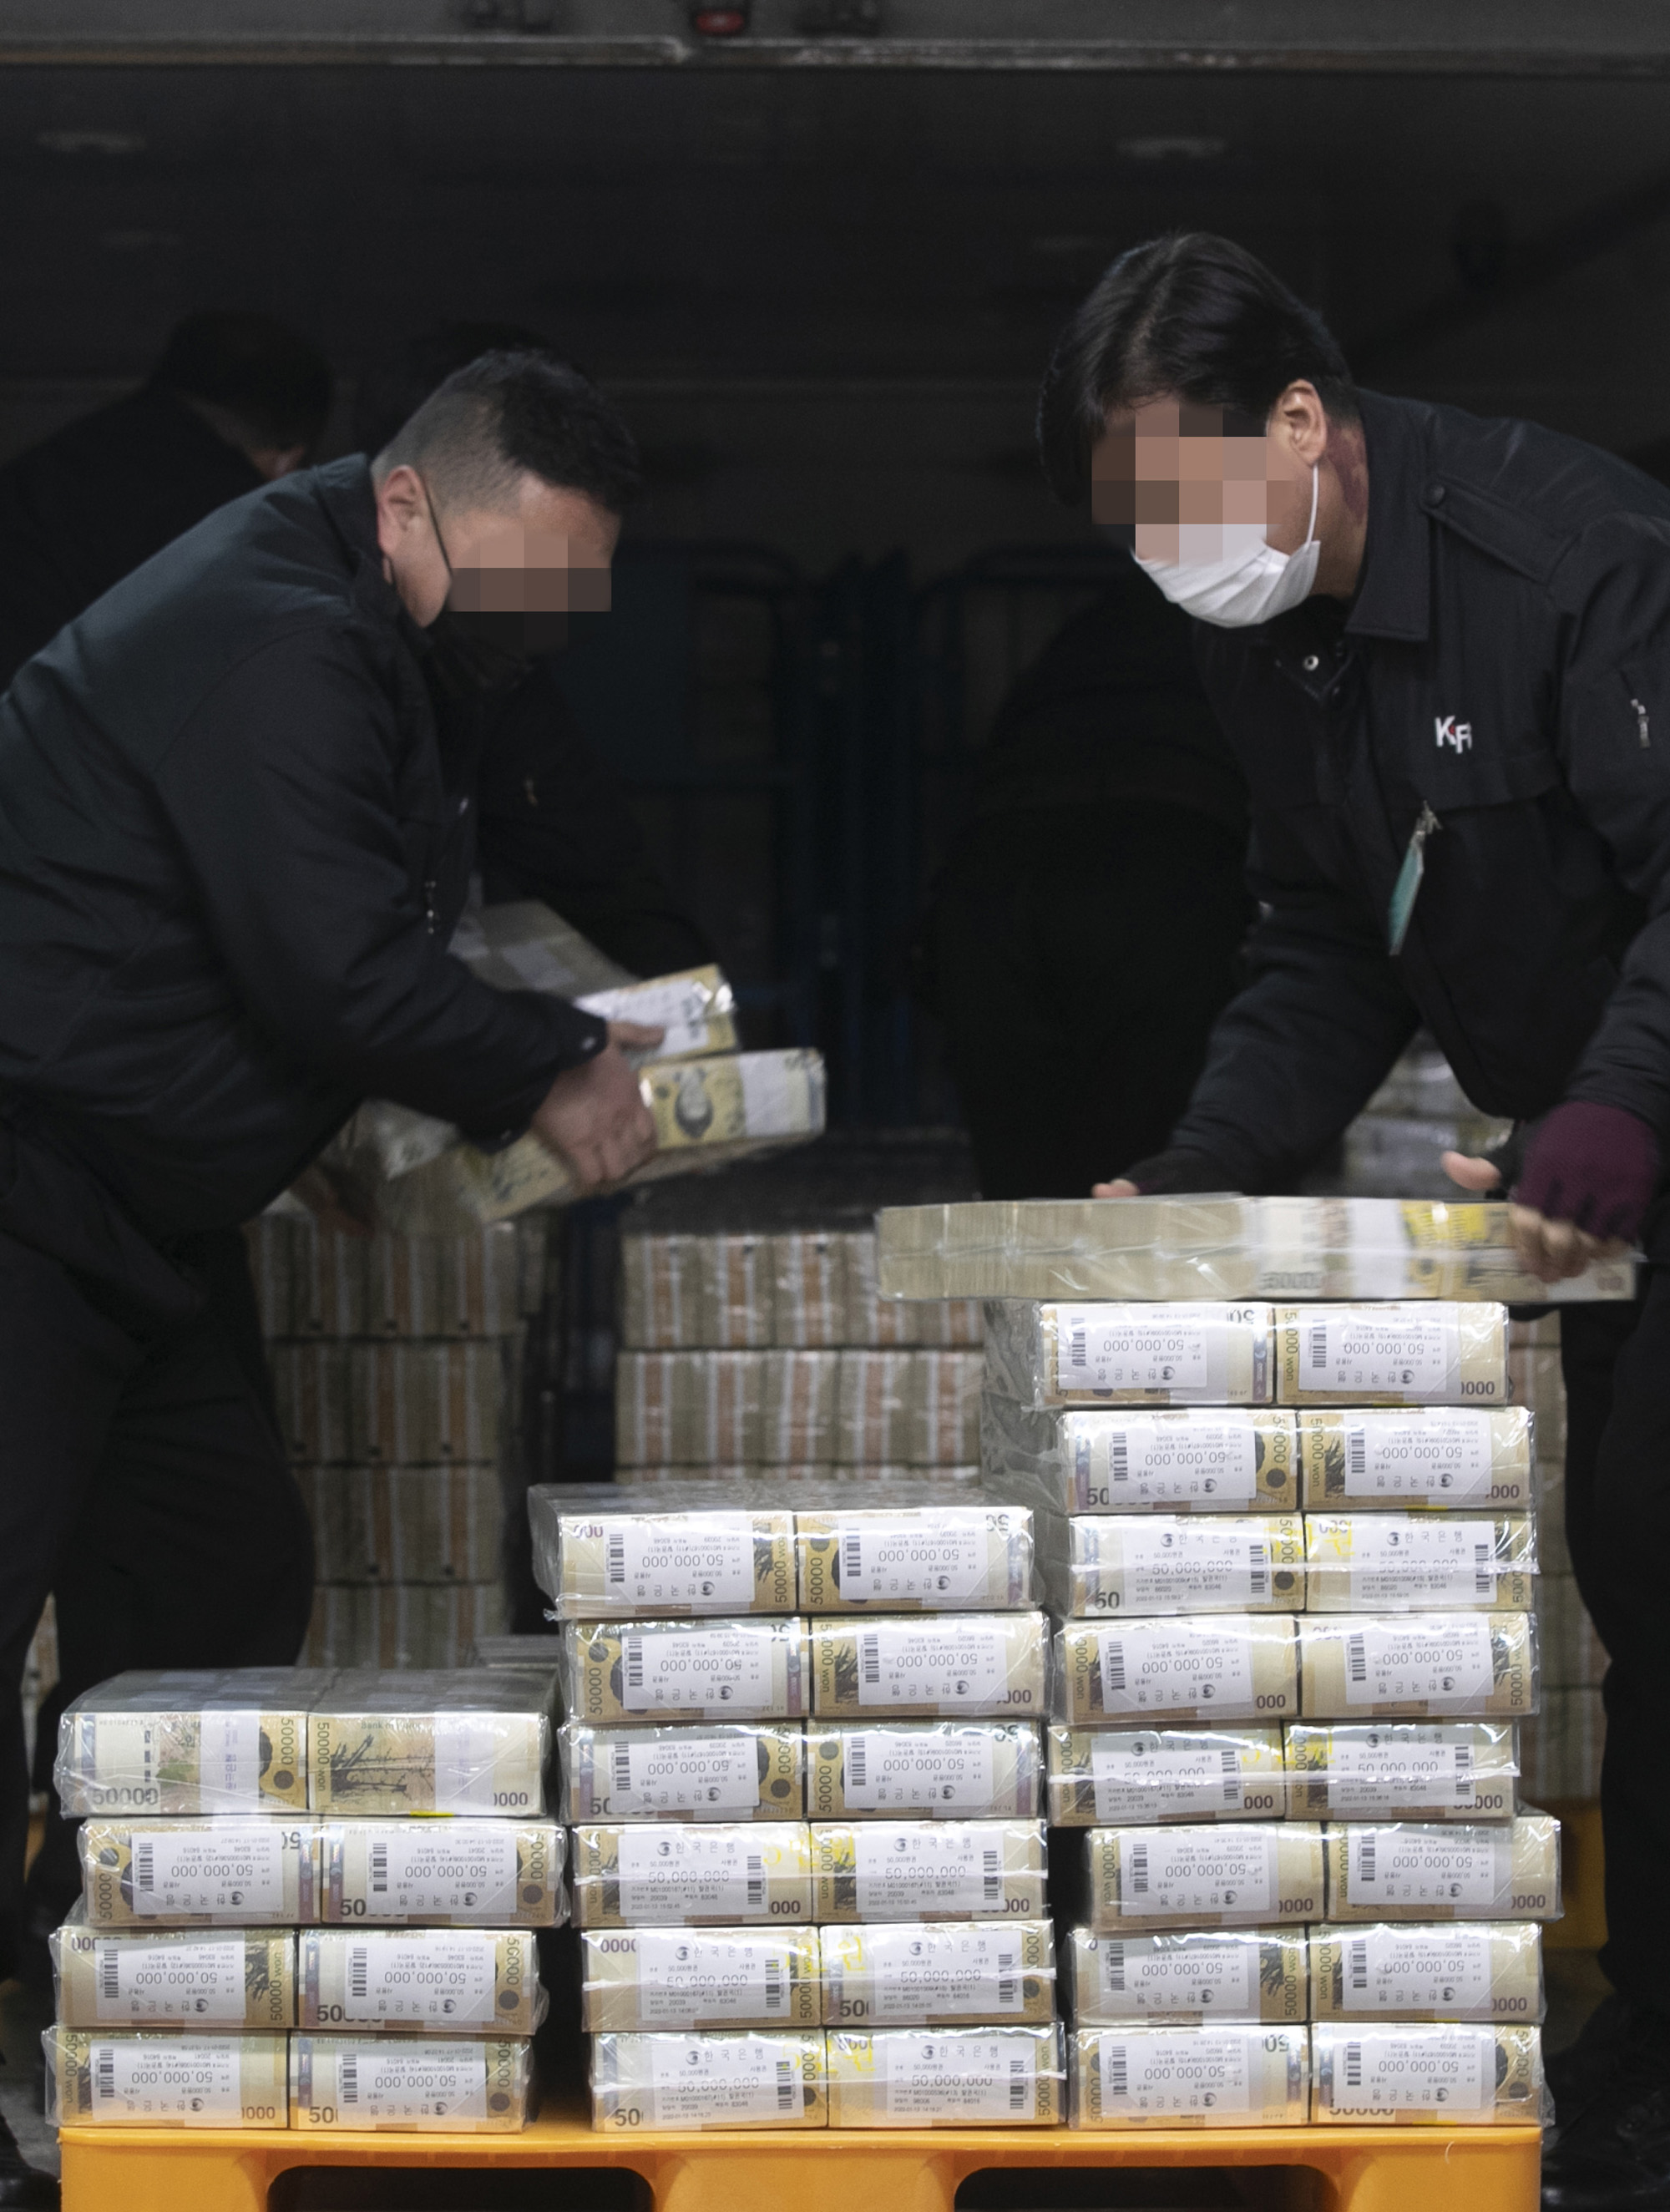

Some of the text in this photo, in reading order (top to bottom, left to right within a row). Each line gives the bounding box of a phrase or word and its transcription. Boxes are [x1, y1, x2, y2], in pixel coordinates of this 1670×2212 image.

[1104, 1339, 1184, 1352] 50,000,000
[1344, 1341, 1424, 1354] 50,000,000
[1145, 1450, 1226, 1465] 50,000,000
[1383, 1445, 1461, 1458] 50,000,000
[642, 1553, 723, 1567] 50,000,000
[878, 1547, 959, 1562] 50,000,000
[774, 1561, 787, 1602] 50000
[811, 1557, 823, 1605] 50000
[897, 1652, 978, 1667] 50,000,000
[1142, 1655, 1222, 1673] 50,000,000
[1383, 1648, 1463, 1665] 50,000,000
[660, 1658, 741, 1671] 50,000,000
[589, 1668, 602, 1715] 50000
[281, 1717, 294, 1765] 50000
[317, 1722, 329, 1764] 50000
[648, 1759, 729, 1774] 50,000,000
[883, 1757, 964, 1770] 50,000,000
[819, 1766, 832, 1812] 50000
[1393, 1855, 1472, 1867] 50,000,000
[171, 1864, 253, 1876] 50,000,000
[405, 1865, 487, 1877] 50,000,000
[885, 1866, 966, 1880] 50,000,000
[1166, 1862, 1246, 1876] 50,000,000
[649, 1870, 729, 1885] 50,000,000
[507, 1936, 519, 1985] 50000
[1384, 1959, 1464, 1972] 50,000,000
[1142, 1961, 1222, 1976] 50,000,000
[137, 1971, 217, 1984] 50,000,000
[385, 1971, 466, 1983] 50,000,000
[270, 1980, 282, 2021] 50000
[65, 2034, 77, 2077] 50000
[1145, 2064, 1225, 2079] 50,000,000
[1379, 2059, 1459, 2072] 50,000,000
[132, 2070, 212, 2083] 50,000,000
[375, 2074, 456, 2087] 50,000,000
